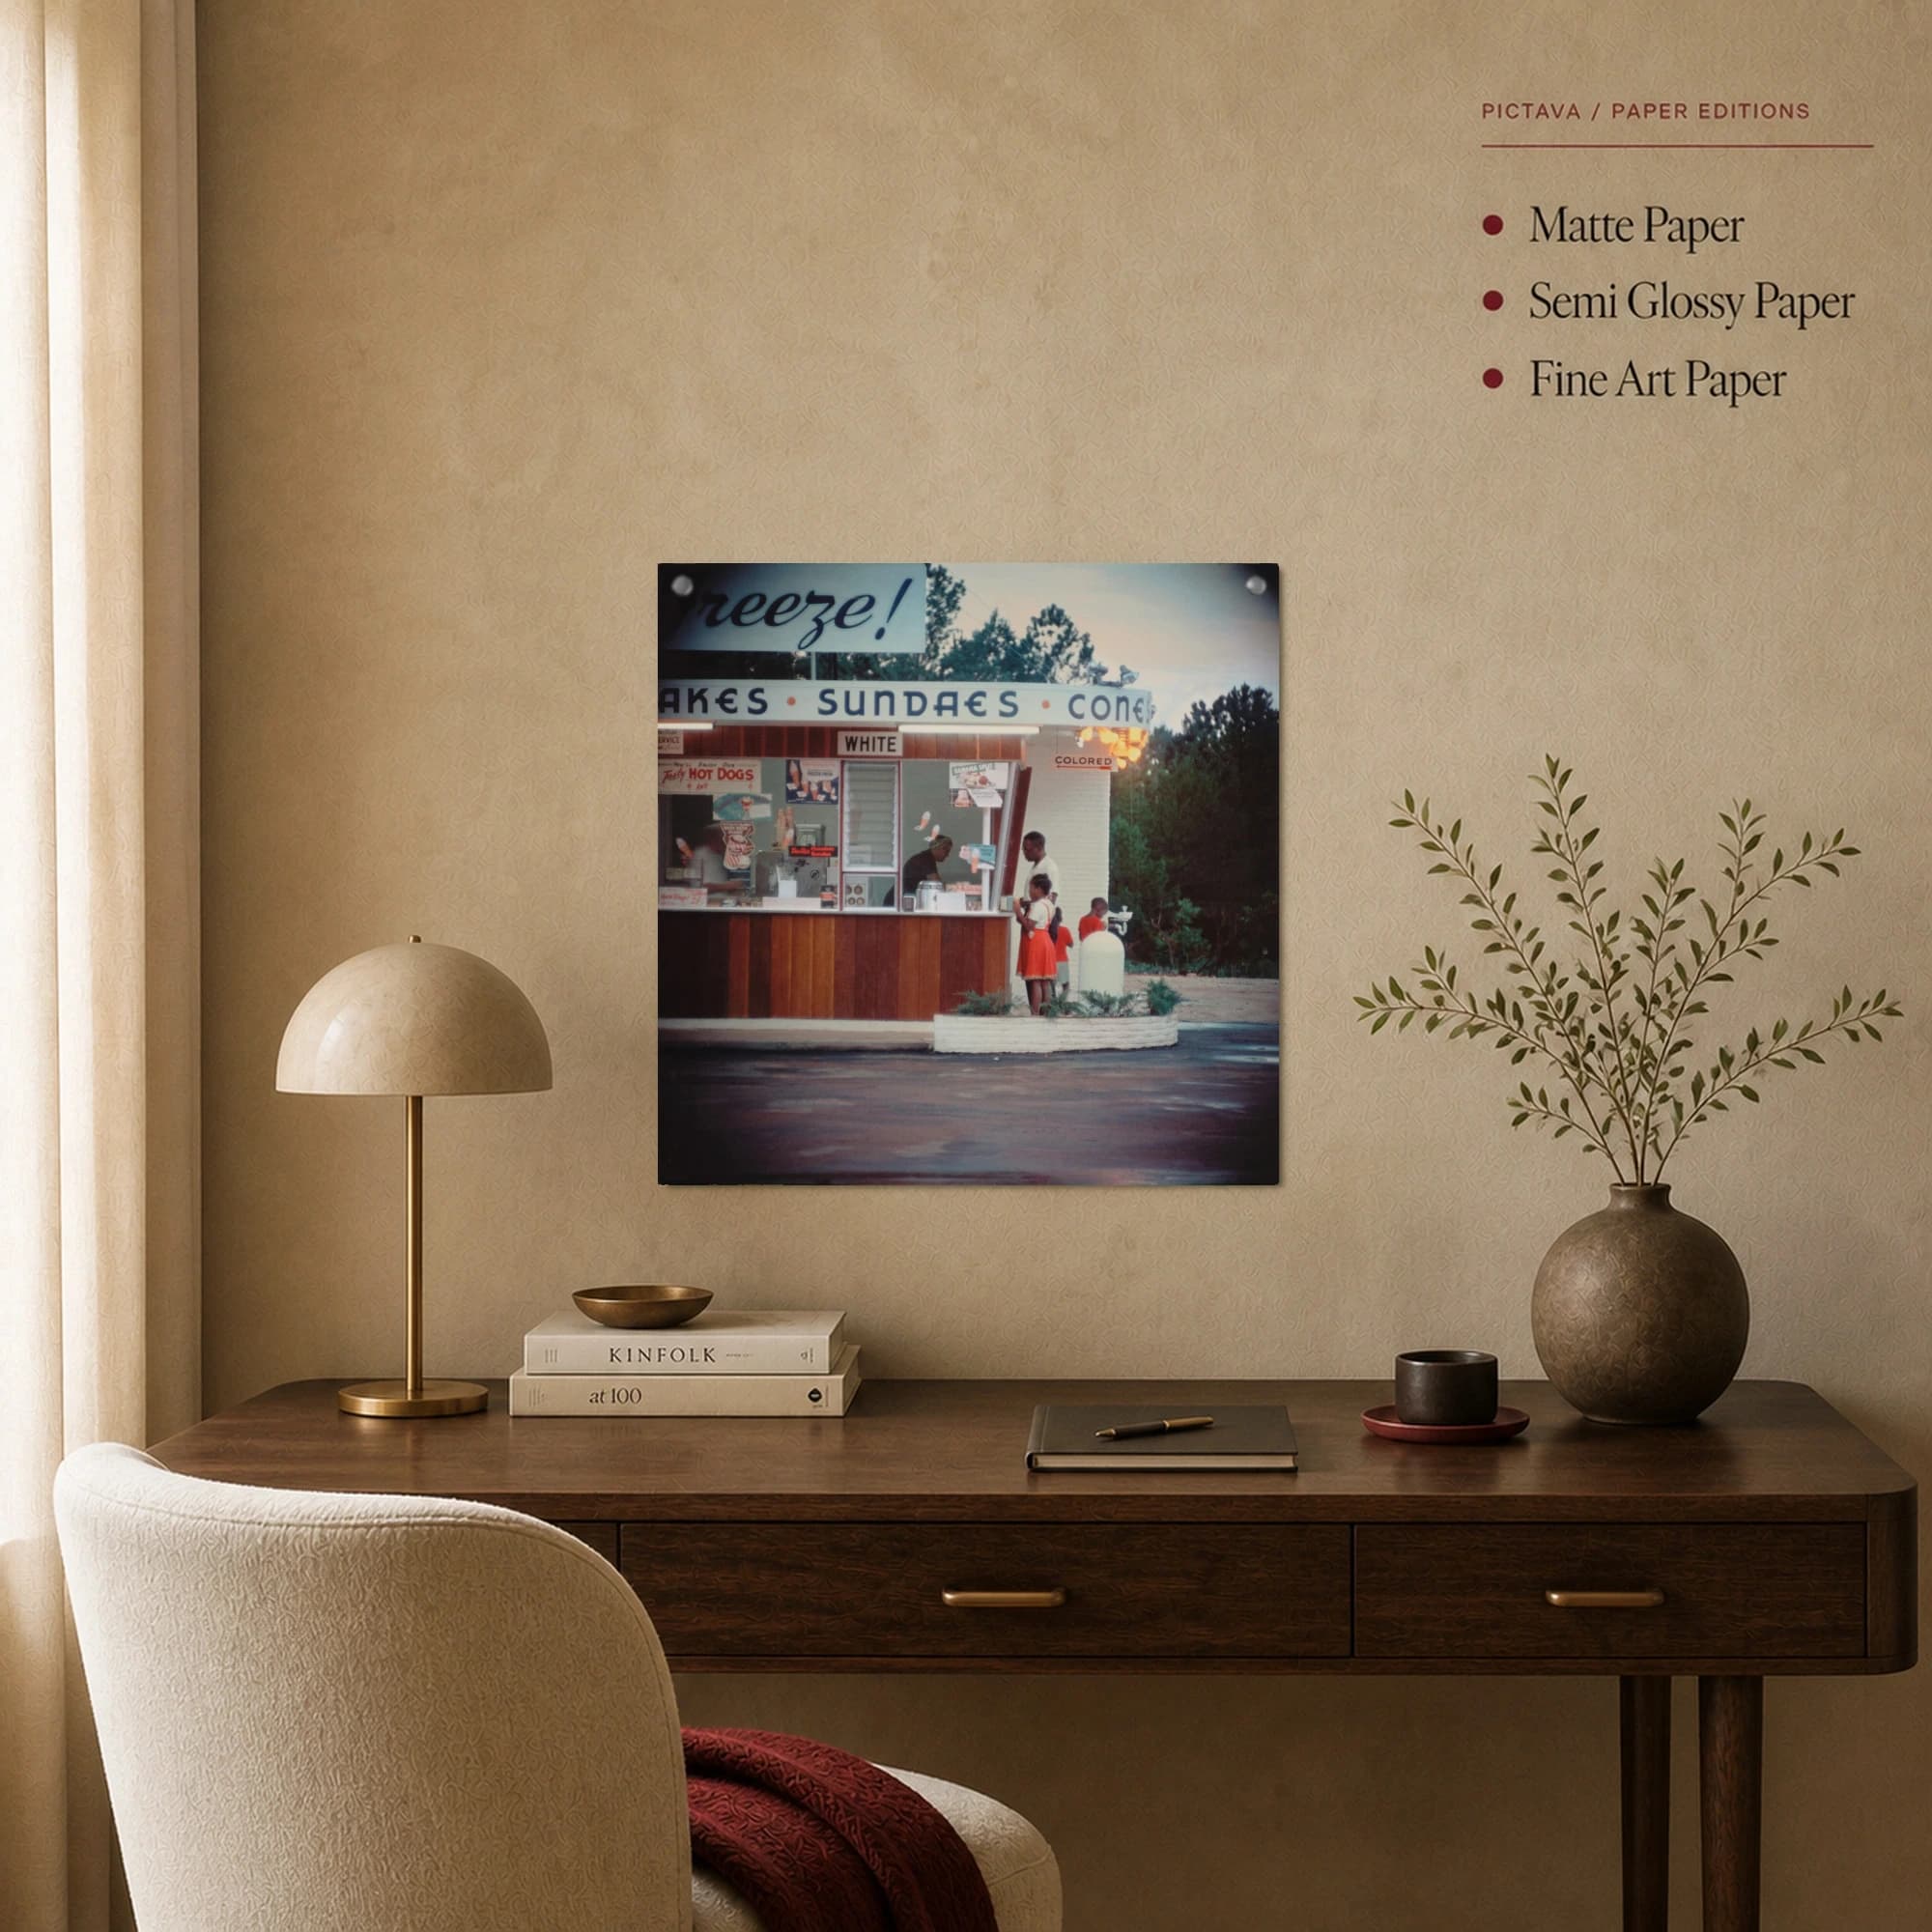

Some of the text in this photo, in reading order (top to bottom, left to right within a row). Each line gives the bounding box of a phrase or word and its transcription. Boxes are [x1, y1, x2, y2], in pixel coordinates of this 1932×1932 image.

[844, 736, 897, 753] WHITE
[1054, 755, 1113, 766] COLORED
[688, 767, 715, 781] HOT
[717, 767, 754, 781] DOGS
[609, 1347, 717, 1364] KINFOLK
[588, 1389, 606, 1405] at
